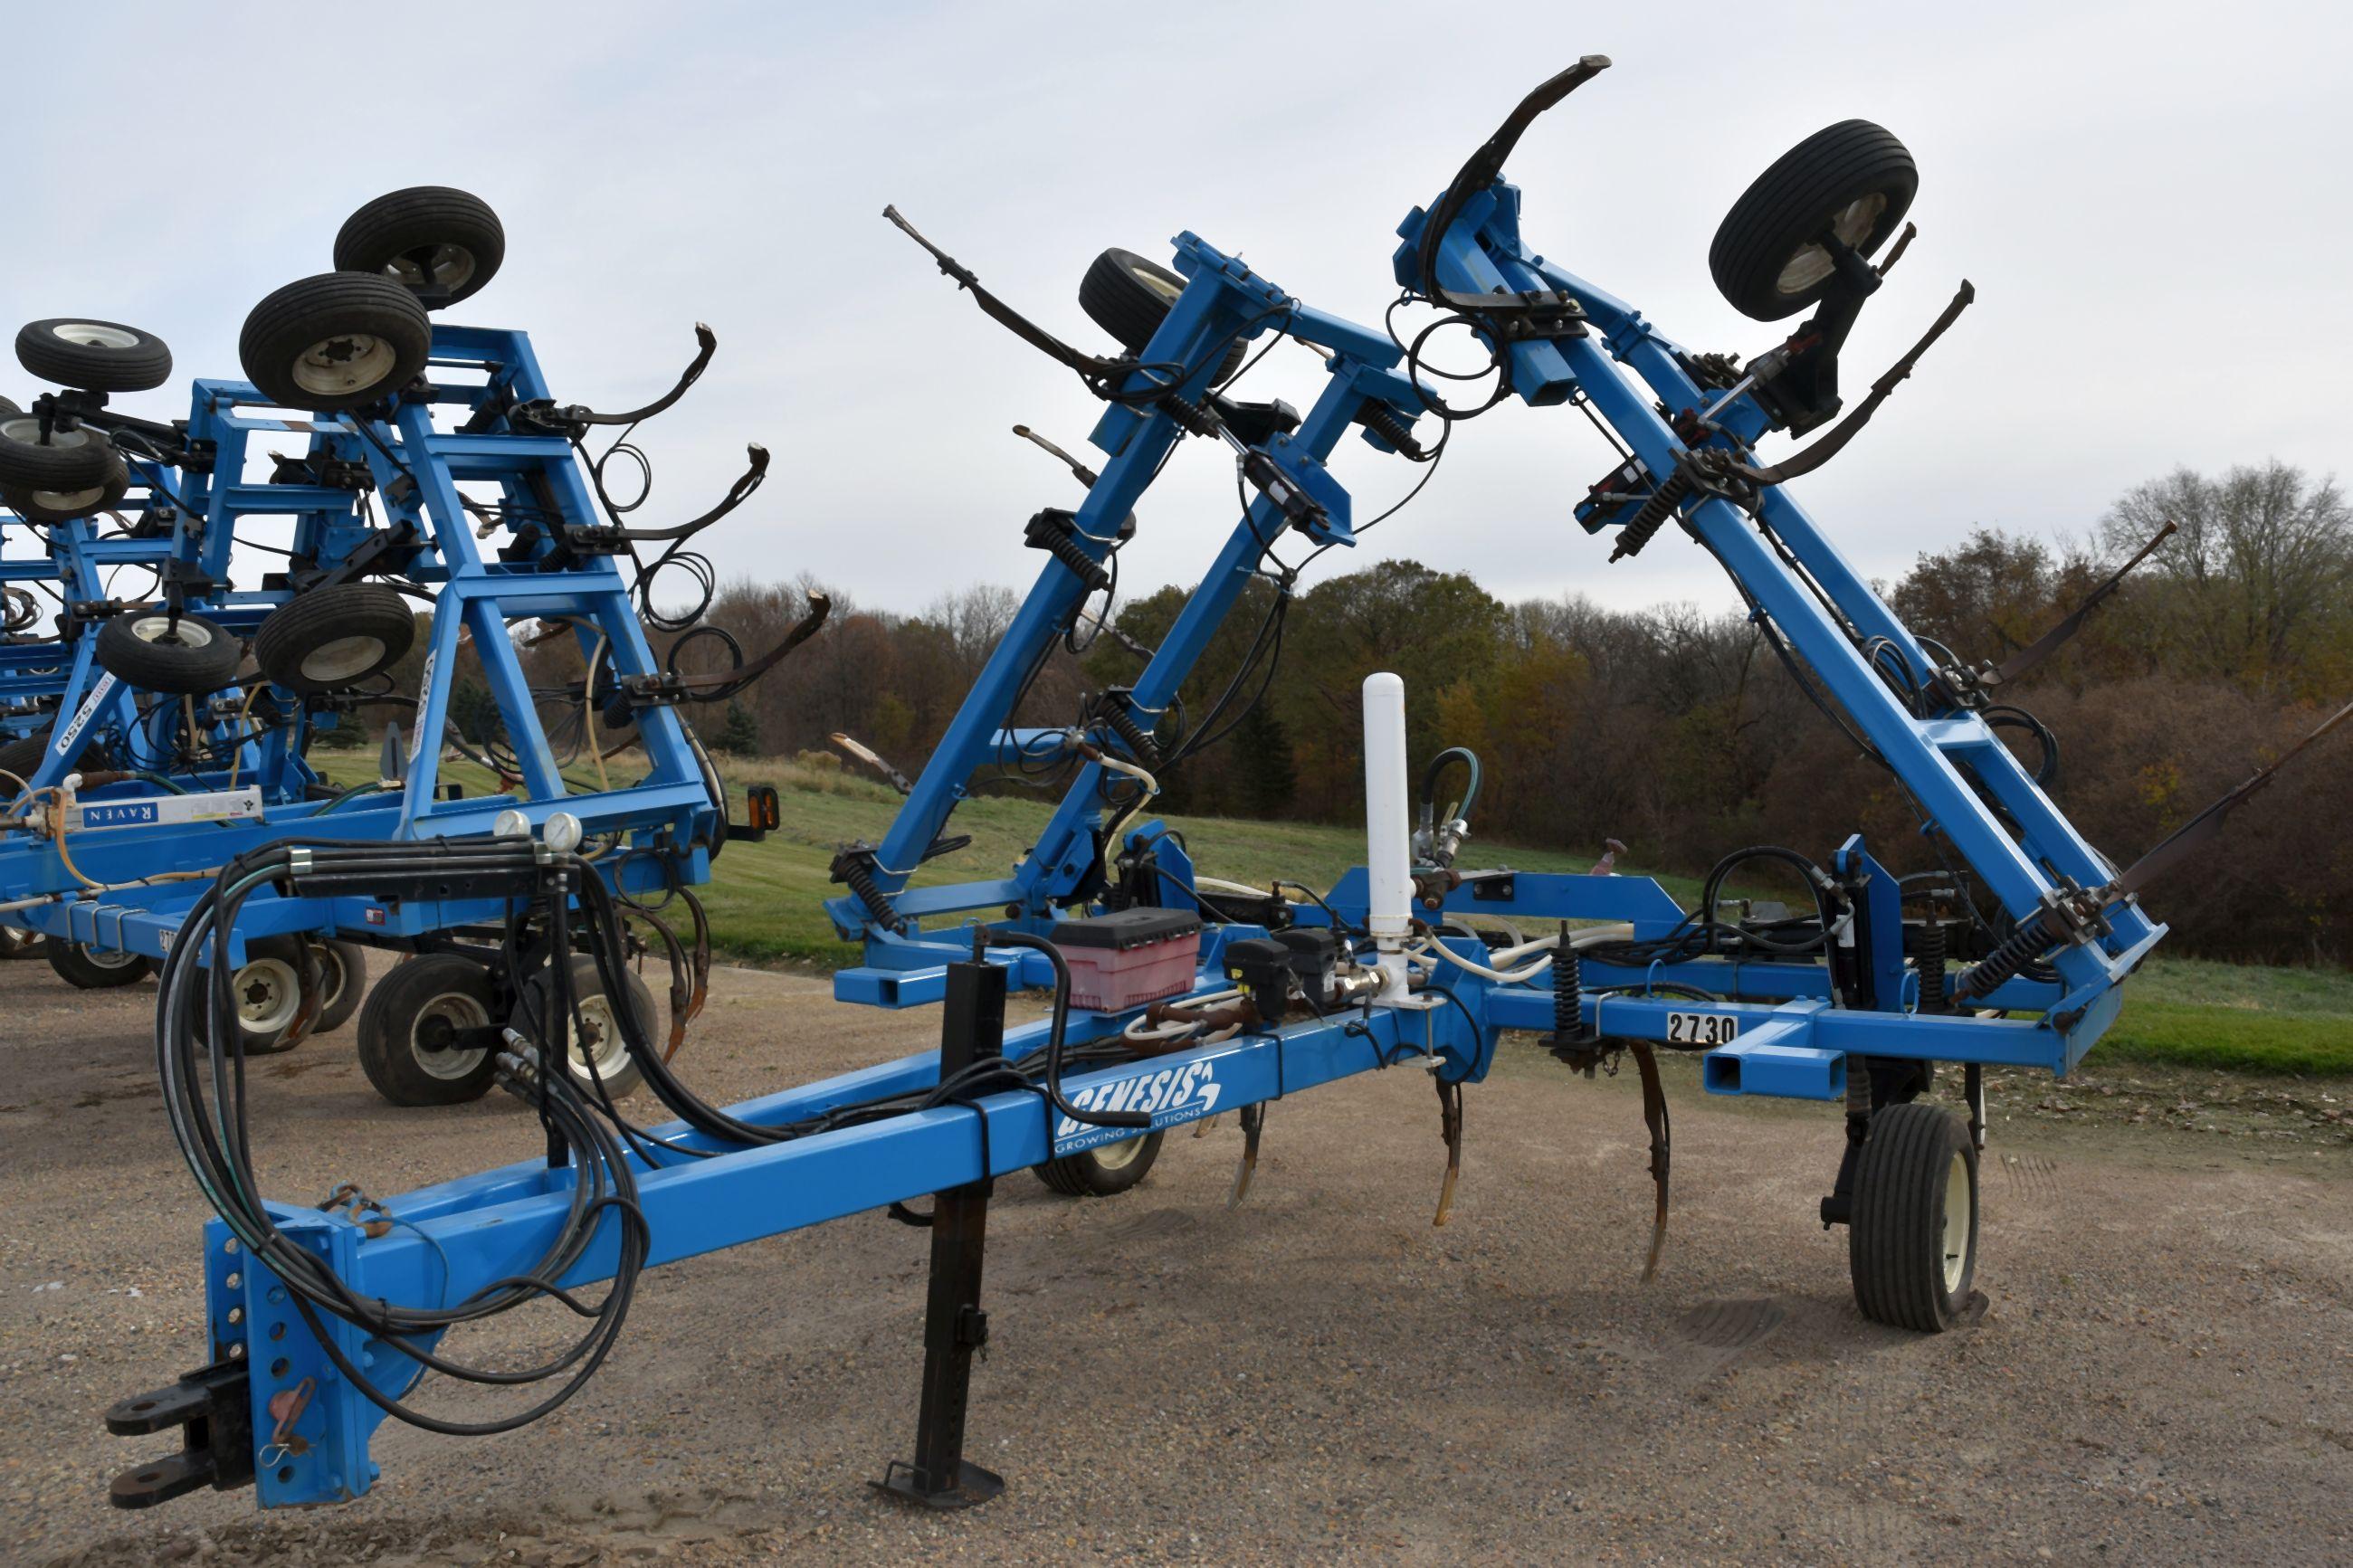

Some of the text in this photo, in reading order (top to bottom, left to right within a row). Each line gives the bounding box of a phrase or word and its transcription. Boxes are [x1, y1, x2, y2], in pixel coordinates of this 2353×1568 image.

[61, 704, 92, 748] 5250
[90, 804, 152, 820] RAVEN
[1670, 1013, 1735, 1044] 2730
[1057, 1060, 1204, 1137] GENESIS
[1055, 1127, 1125, 1154] GROWING
